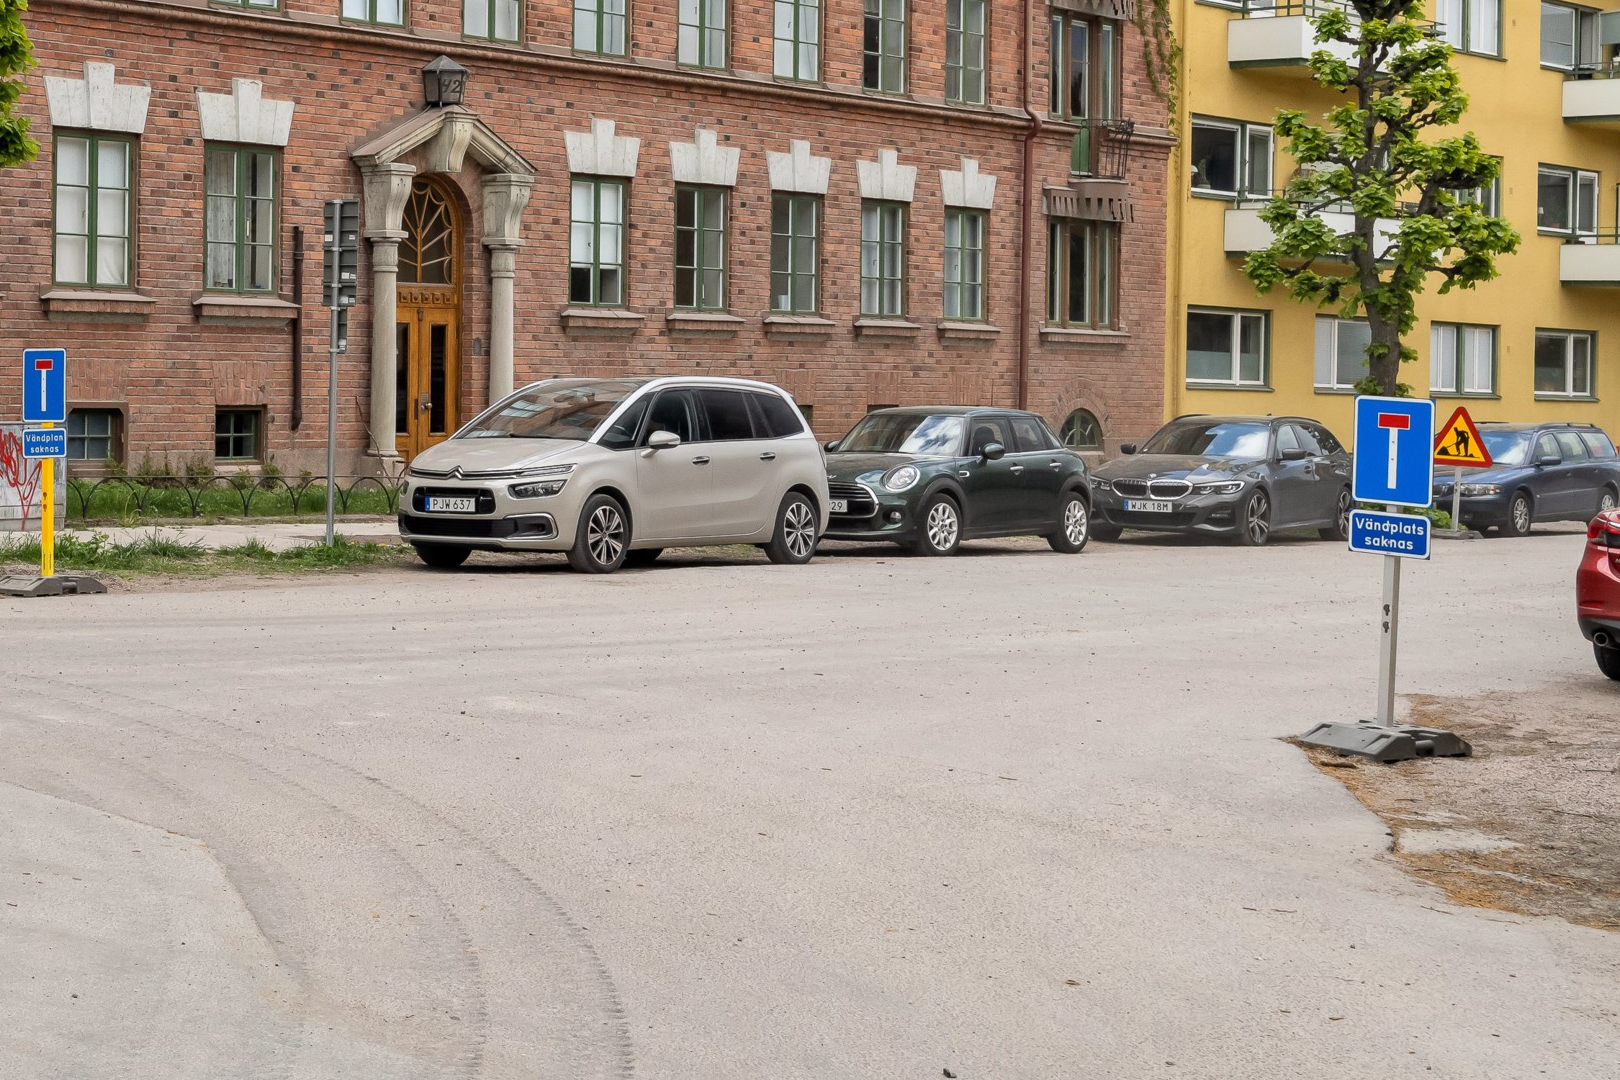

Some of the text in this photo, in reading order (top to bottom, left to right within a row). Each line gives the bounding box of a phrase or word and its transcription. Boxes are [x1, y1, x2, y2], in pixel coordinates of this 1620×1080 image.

[442, 79, 460, 93] 42
[26, 434, 64, 443] Vändplan
[30, 445, 59, 453] saknas
[433, 499, 471, 510] PJW 637
[1131, 501, 1168, 511] WJK 18M
[1355, 517, 1424, 536] Vändplats
[1364, 535, 1414, 550] saknas
